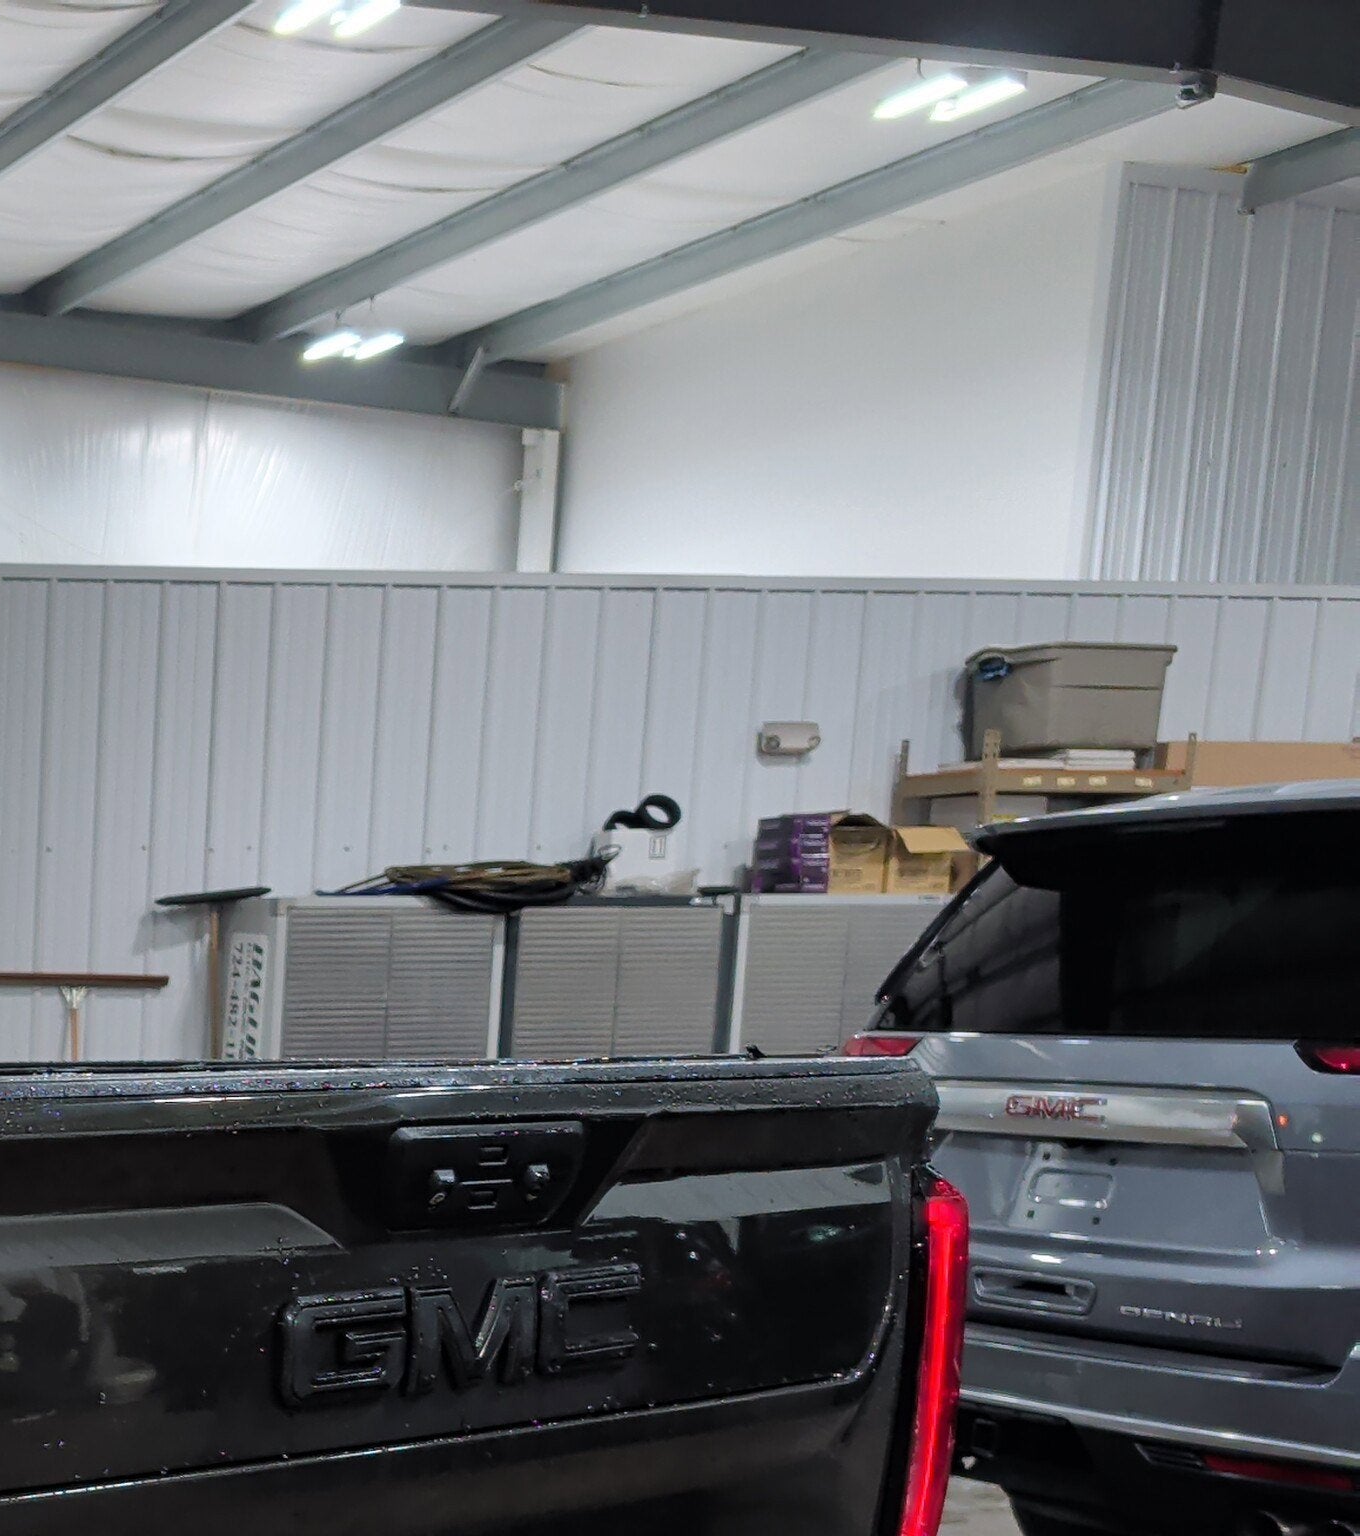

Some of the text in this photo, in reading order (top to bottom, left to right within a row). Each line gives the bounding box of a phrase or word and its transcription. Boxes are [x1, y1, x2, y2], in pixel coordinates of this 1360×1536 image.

[1005, 1095, 1108, 1123] GMC
[1118, 1305, 1243, 1329] DENALI
[283, 1263, 642, 1404] GMC
